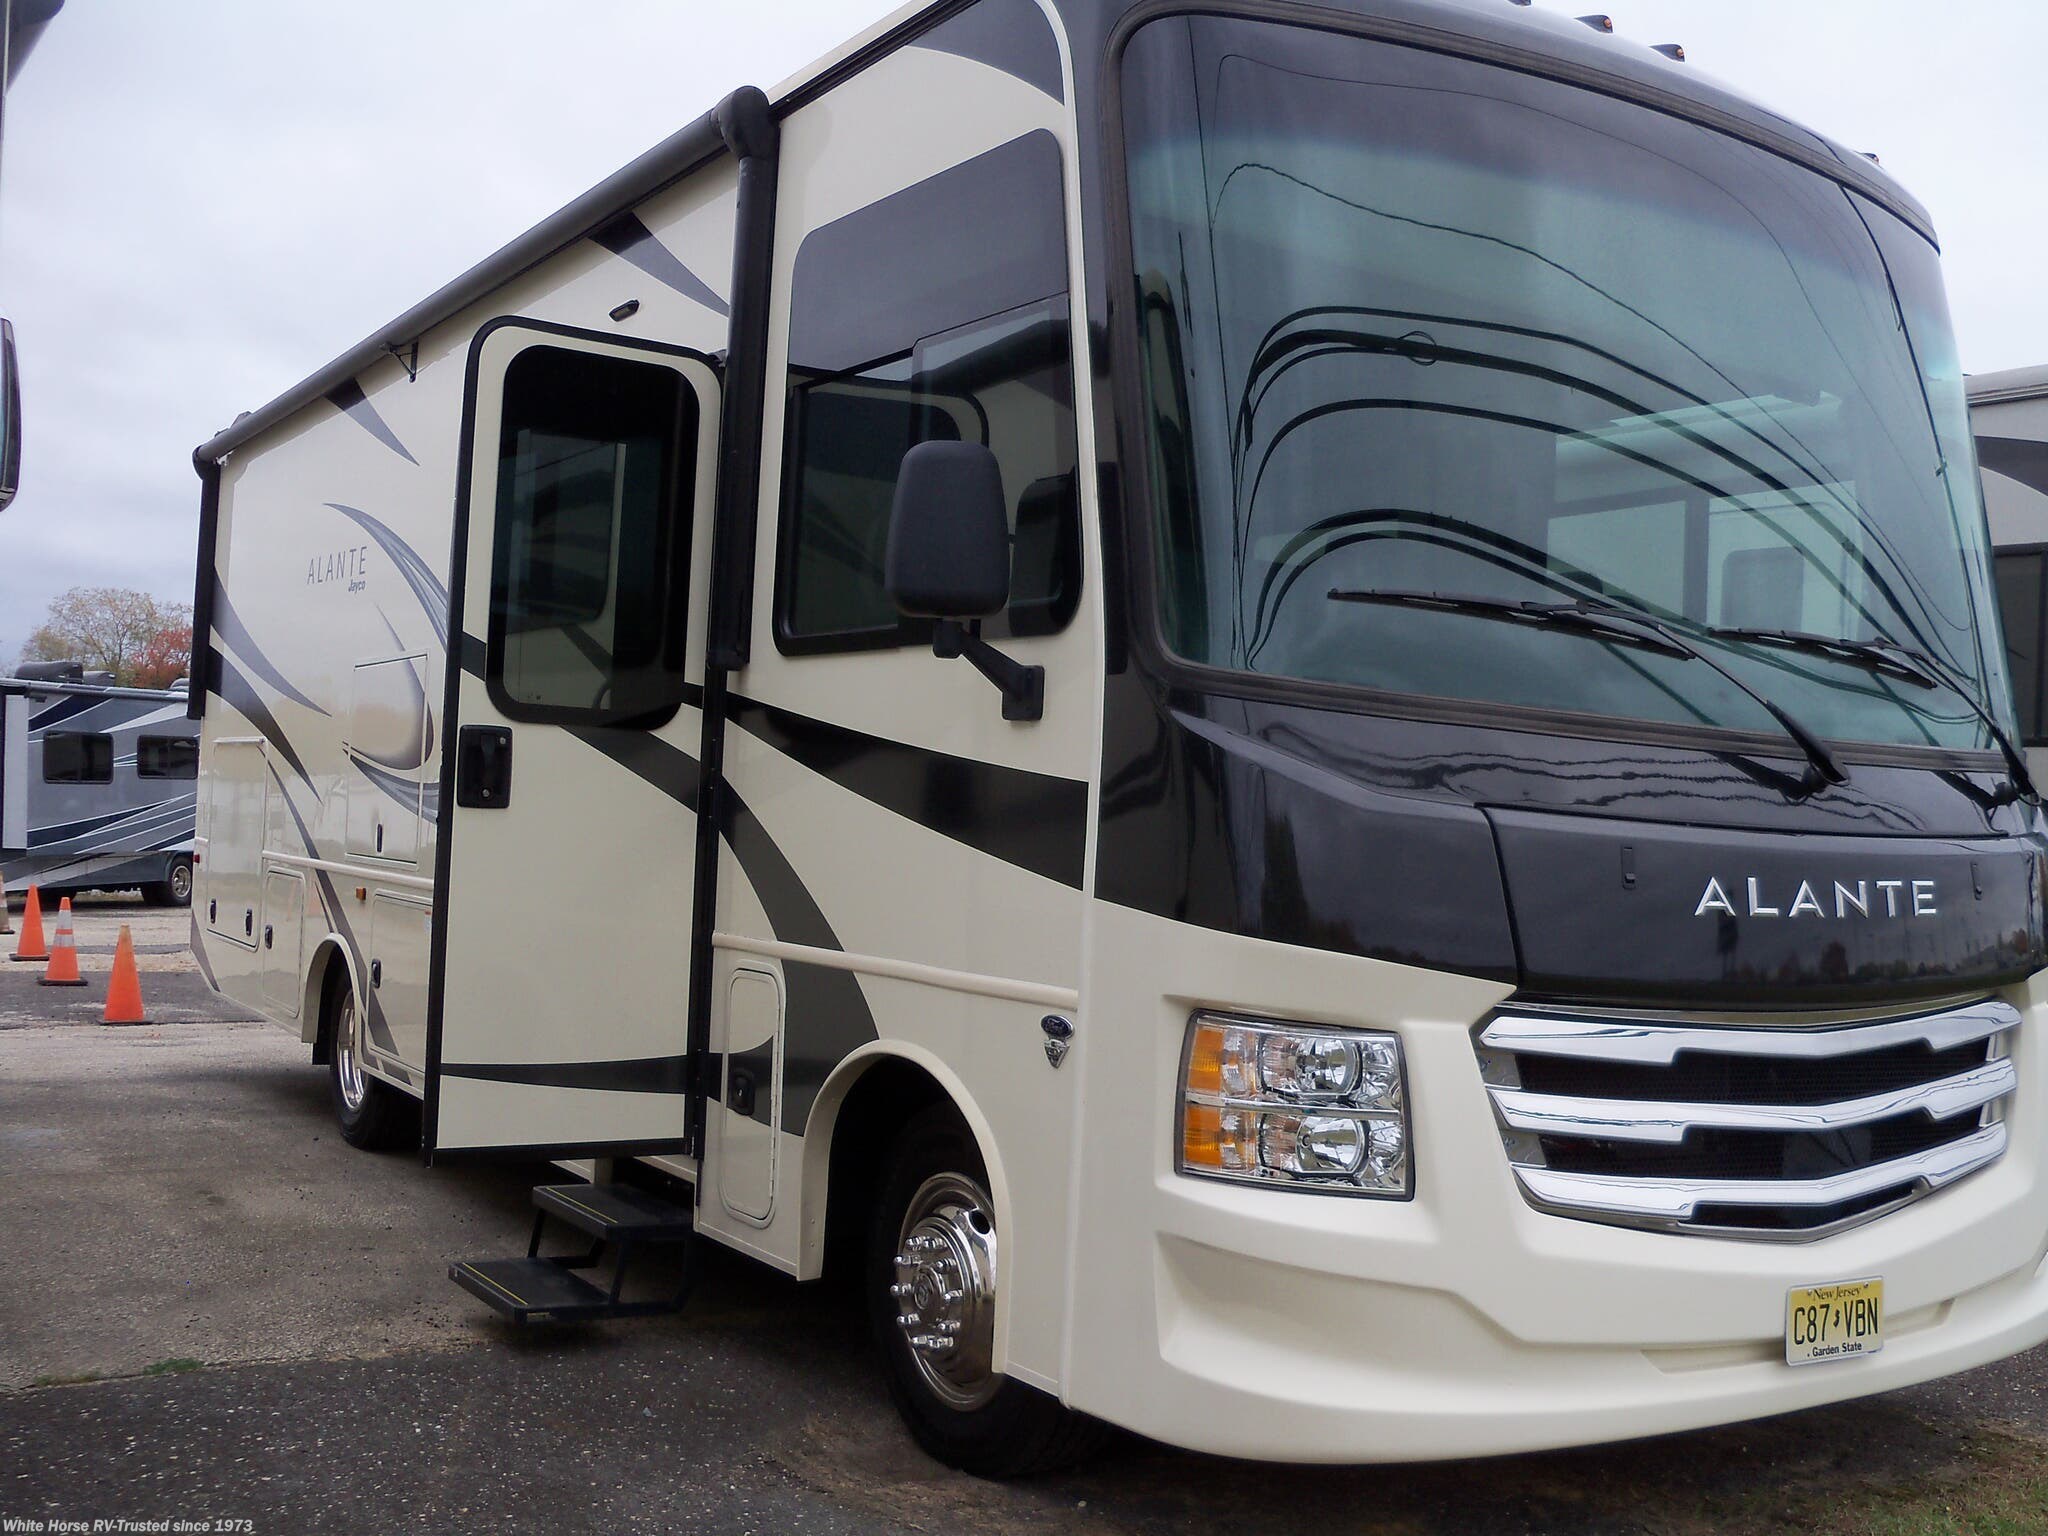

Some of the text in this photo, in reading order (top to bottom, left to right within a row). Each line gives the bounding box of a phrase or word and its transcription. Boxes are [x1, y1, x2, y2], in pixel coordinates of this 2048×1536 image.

[307, 546, 367, 584] ALANTE
[1694, 876, 1937, 918] ALANTE
[1813, 1286, 1861, 1300] New Jersey
[1794, 1297, 1878, 1345] C87 VBN
[1812, 1342, 1862, 1357] Garden State
